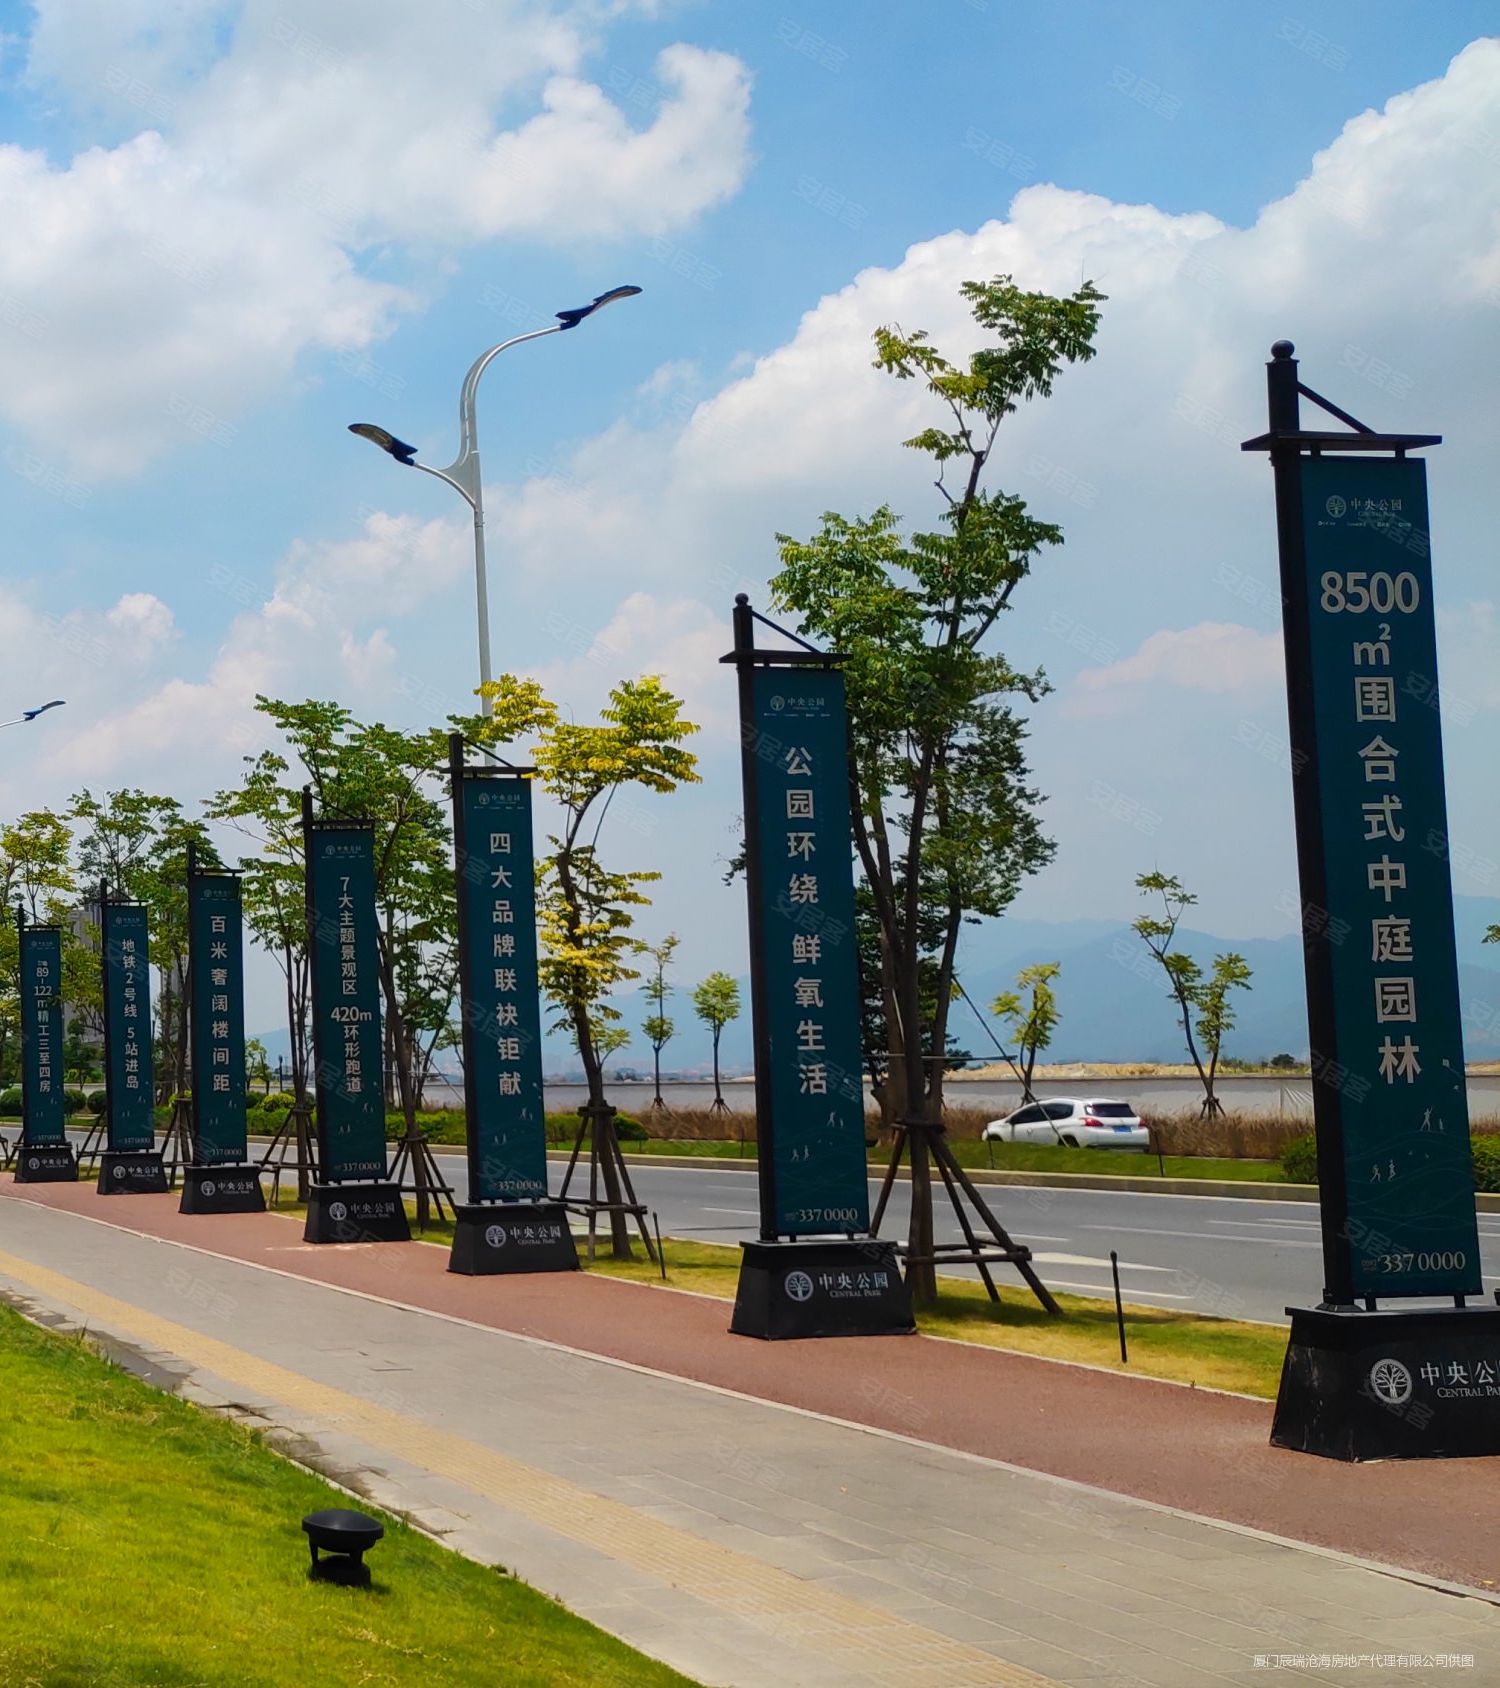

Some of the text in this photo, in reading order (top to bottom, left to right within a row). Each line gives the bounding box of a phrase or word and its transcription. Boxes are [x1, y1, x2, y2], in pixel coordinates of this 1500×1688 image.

[1320, 570, 1420, 614] 8500
[1354, 676, 1422, 1084] 围合式中庭园林
[338, 876, 358, 995] 7大主题景观区
[34, 985, 52, 996] 122
[122, 939, 138, 1018] 地铁2号线
[210, 915, 231, 1092] 百米奢阔楼间距
[331, 1006, 373, 1022] 420m
[791, 934, 828, 1095] 鲜氧生活
[125, 1026, 139, 1089] 5站进岛
[344, 1024, 362, 1093] 环形跑道
[510, 1226, 562, 1239] 中央公园
[819, 1272, 889, 1291] 中央公园
[1420, 1359, 1500, 1387] 中央公
[1437, 1386, 1484, 1399] CENTRAL
